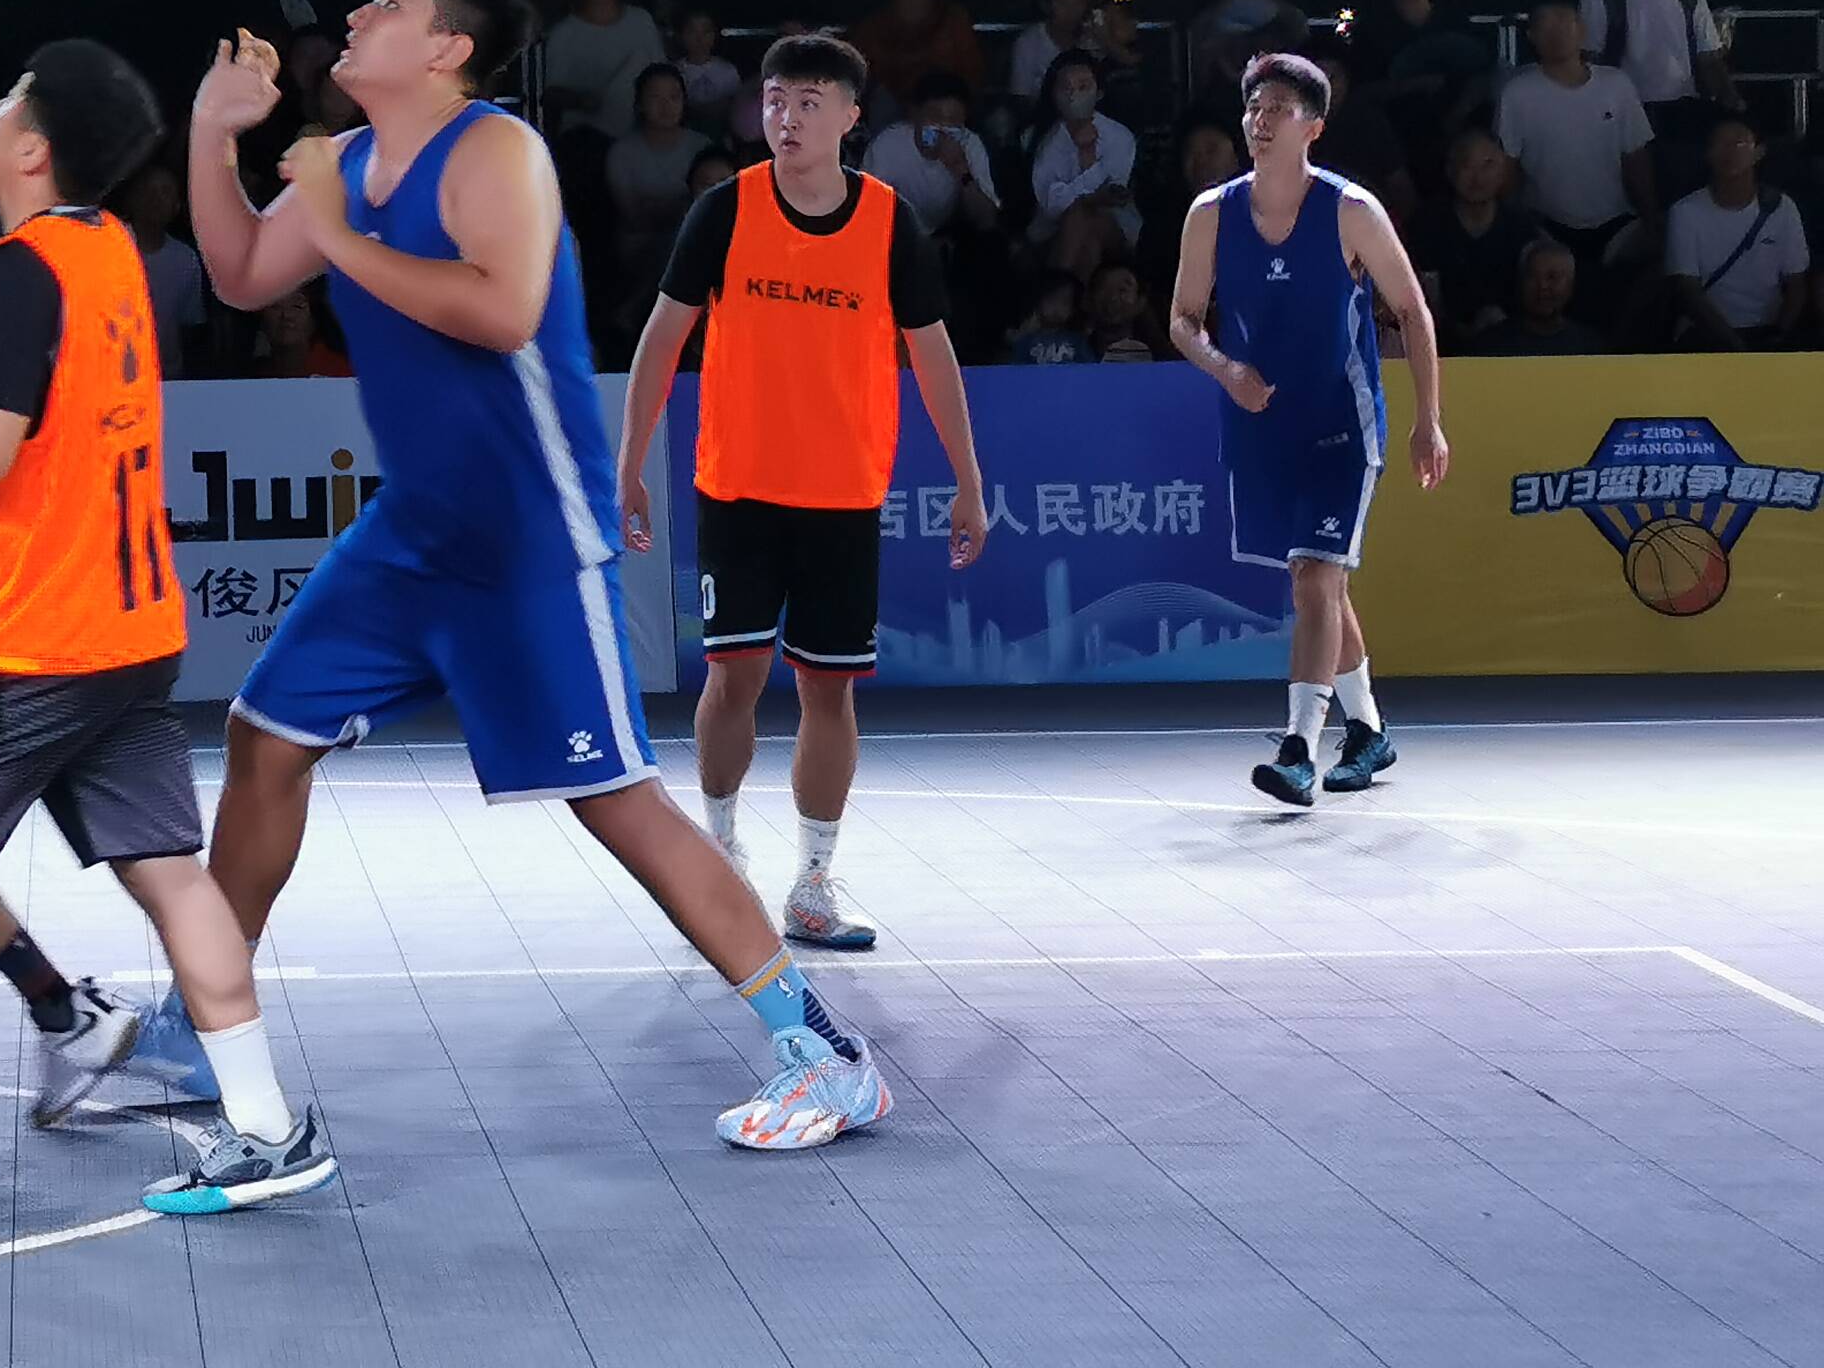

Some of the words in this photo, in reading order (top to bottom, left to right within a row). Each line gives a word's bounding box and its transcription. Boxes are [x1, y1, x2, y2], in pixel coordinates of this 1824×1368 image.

[746, 277, 844, 308] KELME
[1642, 427, 1685, 440] ZIBO
[1613, 442, 1716, 457] ZHANGDIAN
[166, 448, 384, 543] Jwi
